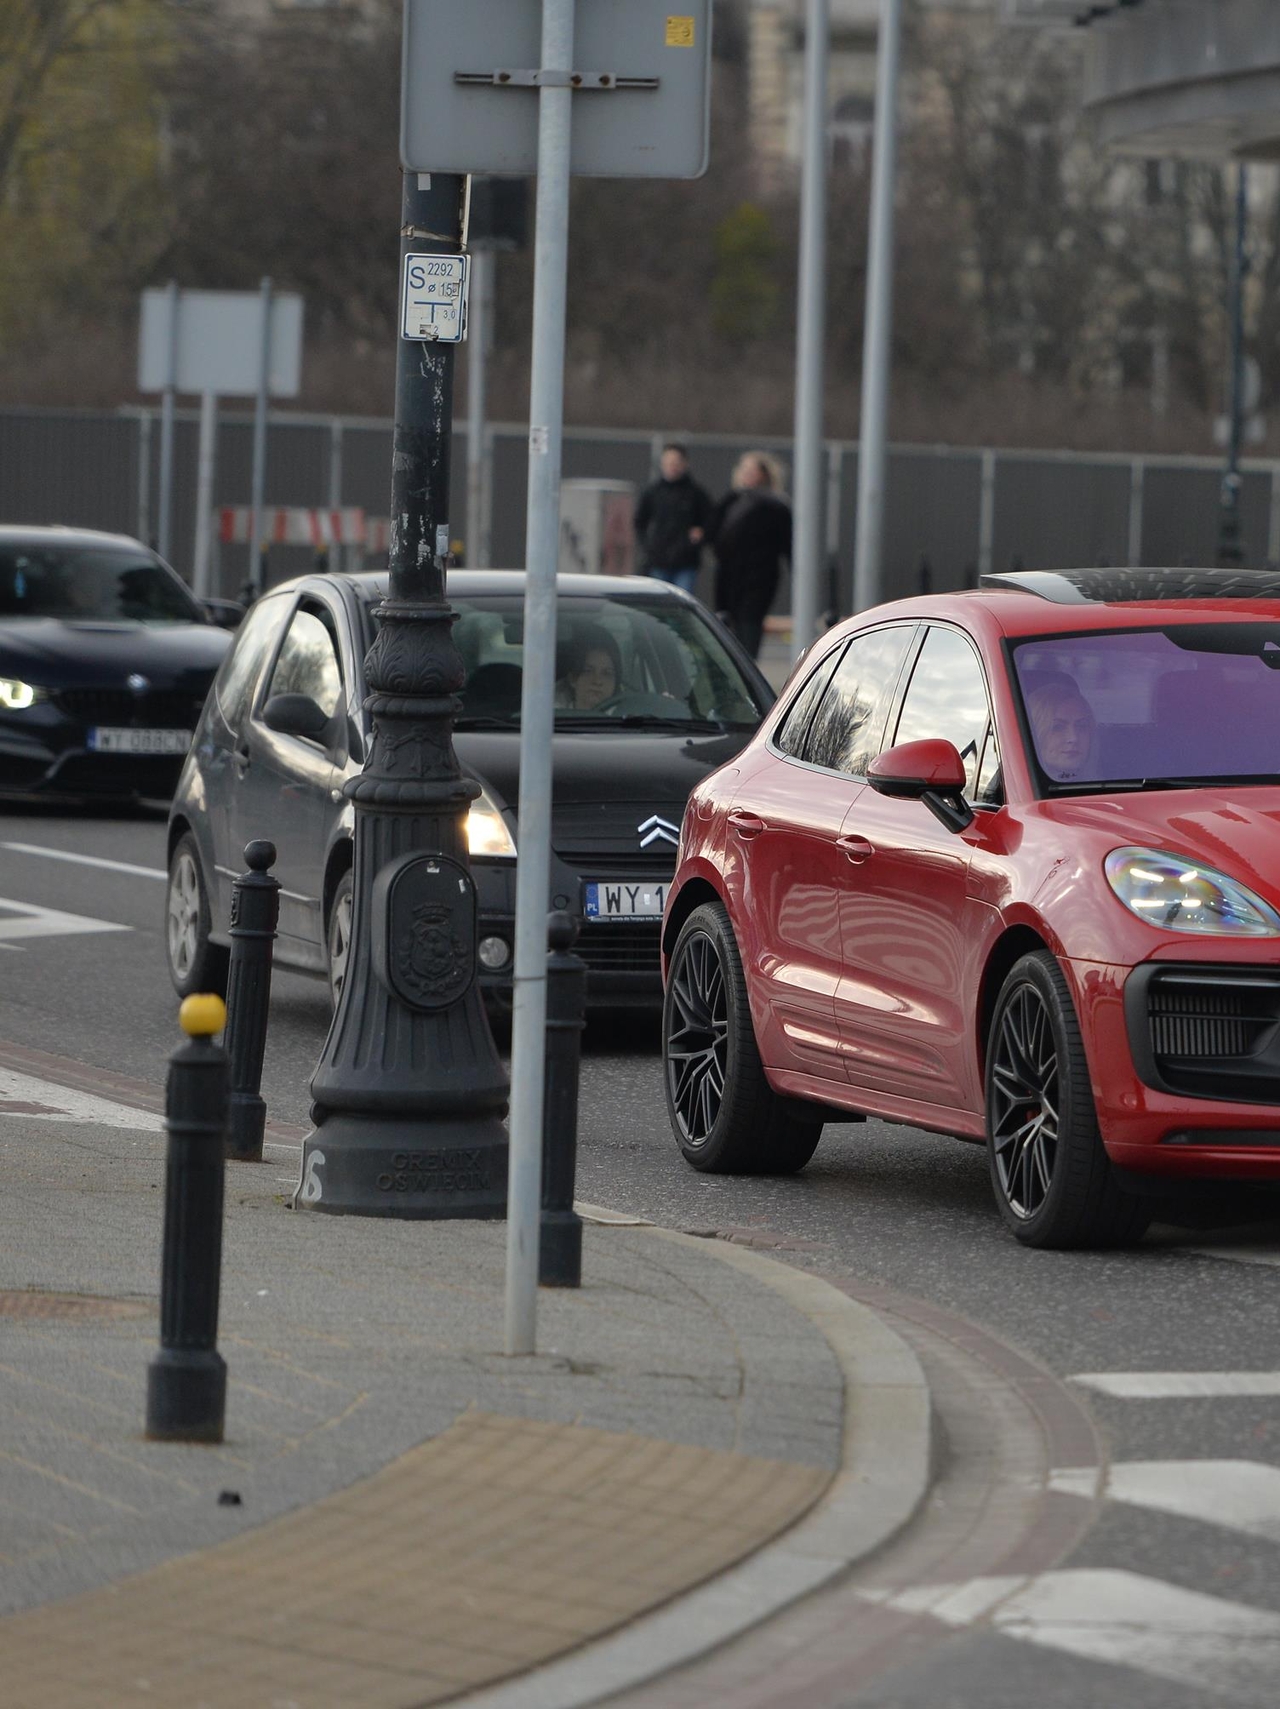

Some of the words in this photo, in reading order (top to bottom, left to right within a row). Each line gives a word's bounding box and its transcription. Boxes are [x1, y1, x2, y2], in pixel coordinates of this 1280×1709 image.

[409, 266, 426, 289] S
[427, 262, 453, 276] 2292
[587, 903, 598, 911] PL
[605, 885, 640, 913] WY
